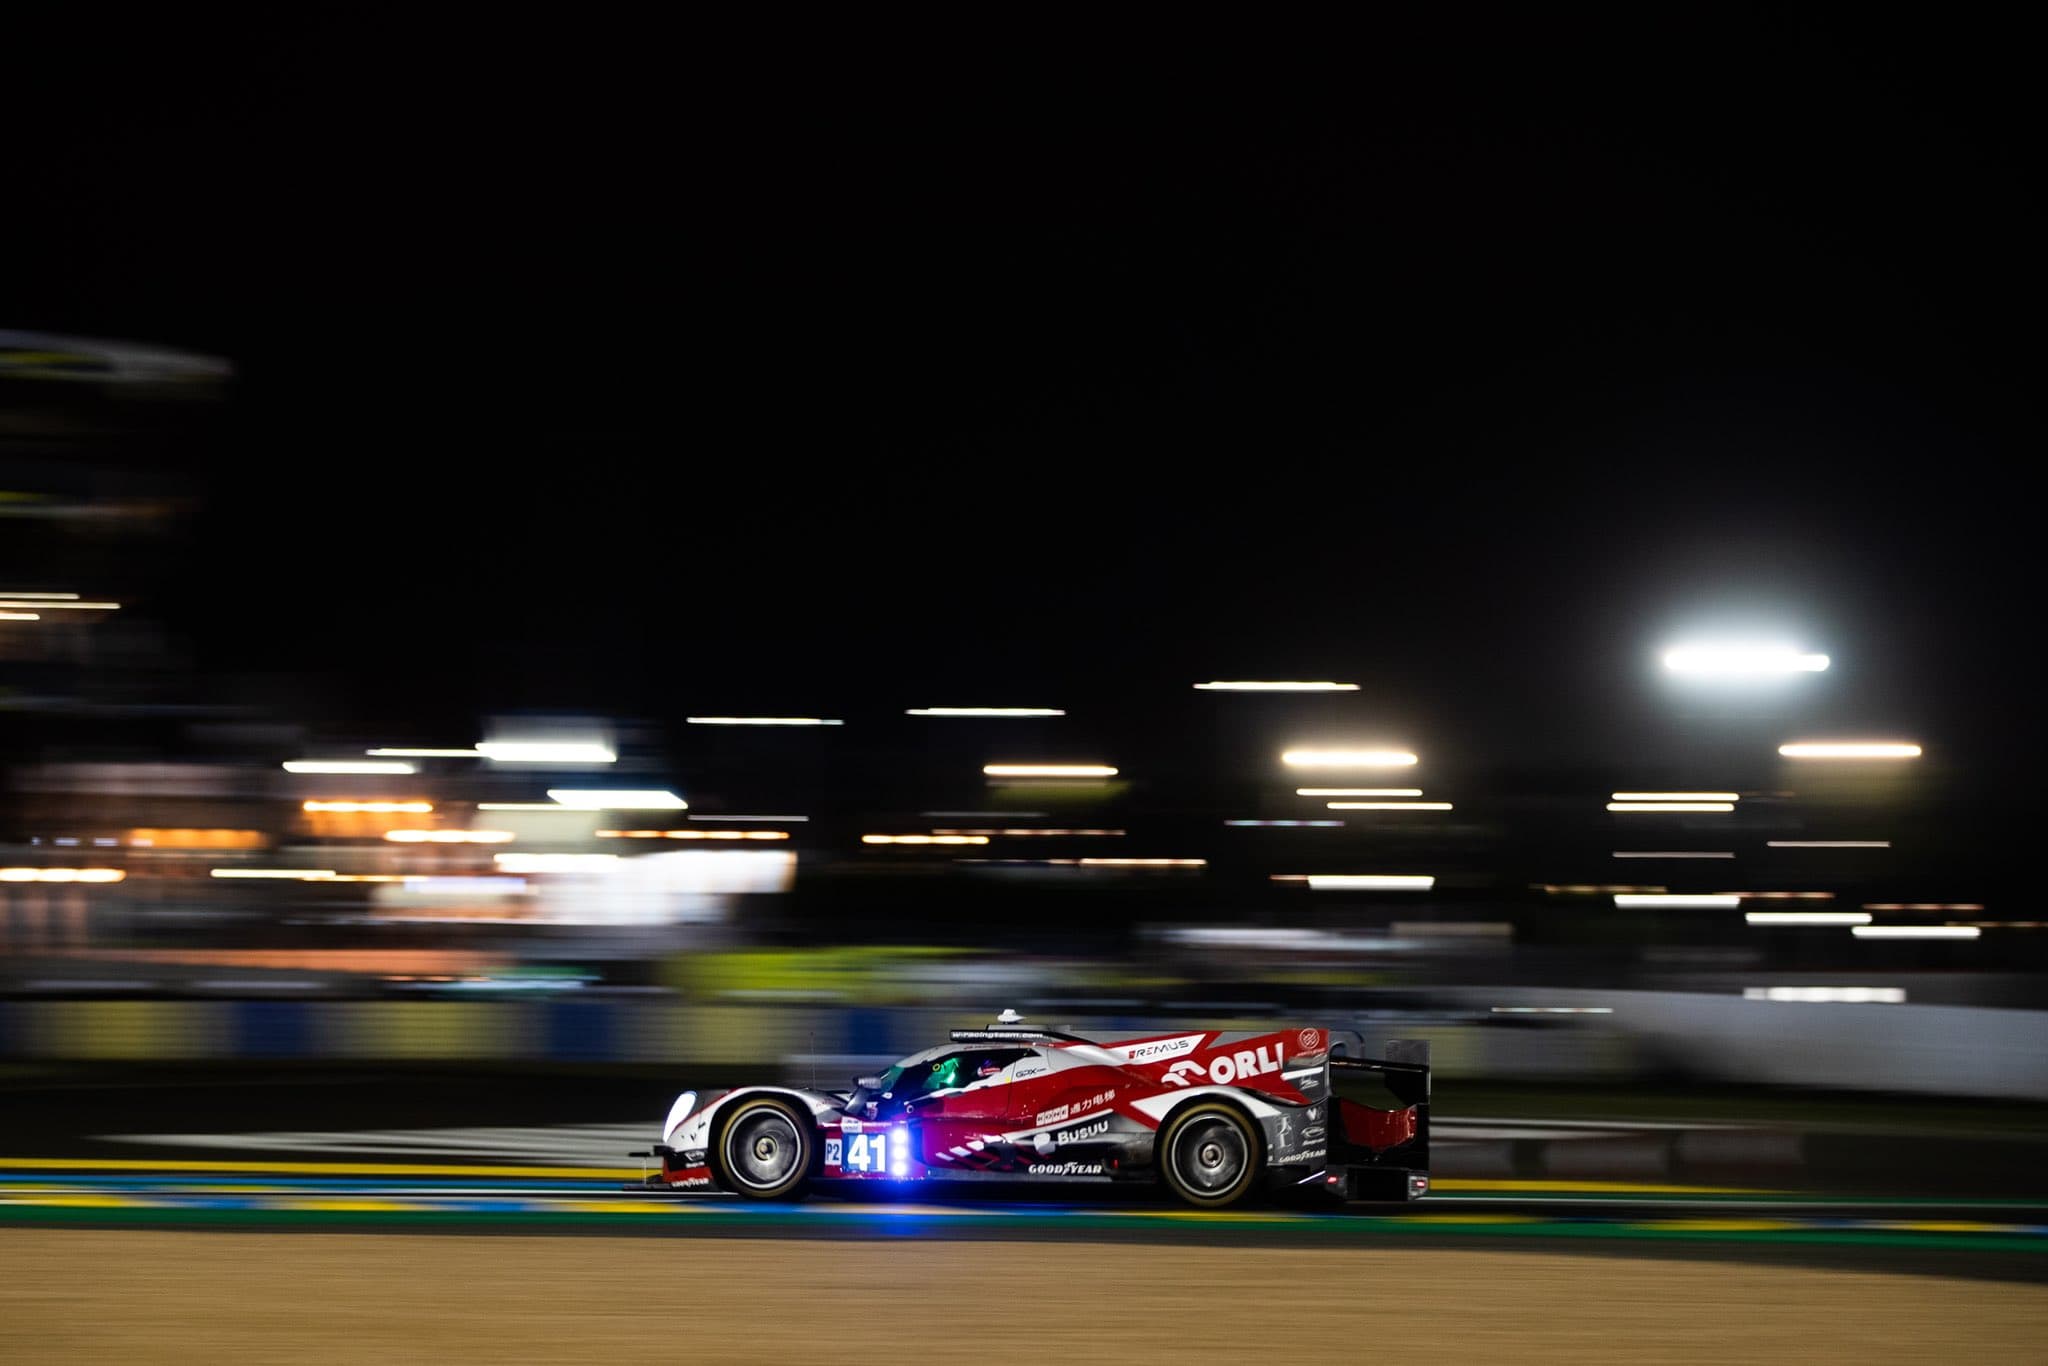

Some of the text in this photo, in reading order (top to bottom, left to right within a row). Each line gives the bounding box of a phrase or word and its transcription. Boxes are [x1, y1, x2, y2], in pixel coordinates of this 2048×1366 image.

[1136, 1040, 1189, 1058] REMUS
[827, 1143, 840, 1161] P2
[848, 1134, 886, 1172] 41
[1028, 1161, 1102, 1176] GOODYEAR
